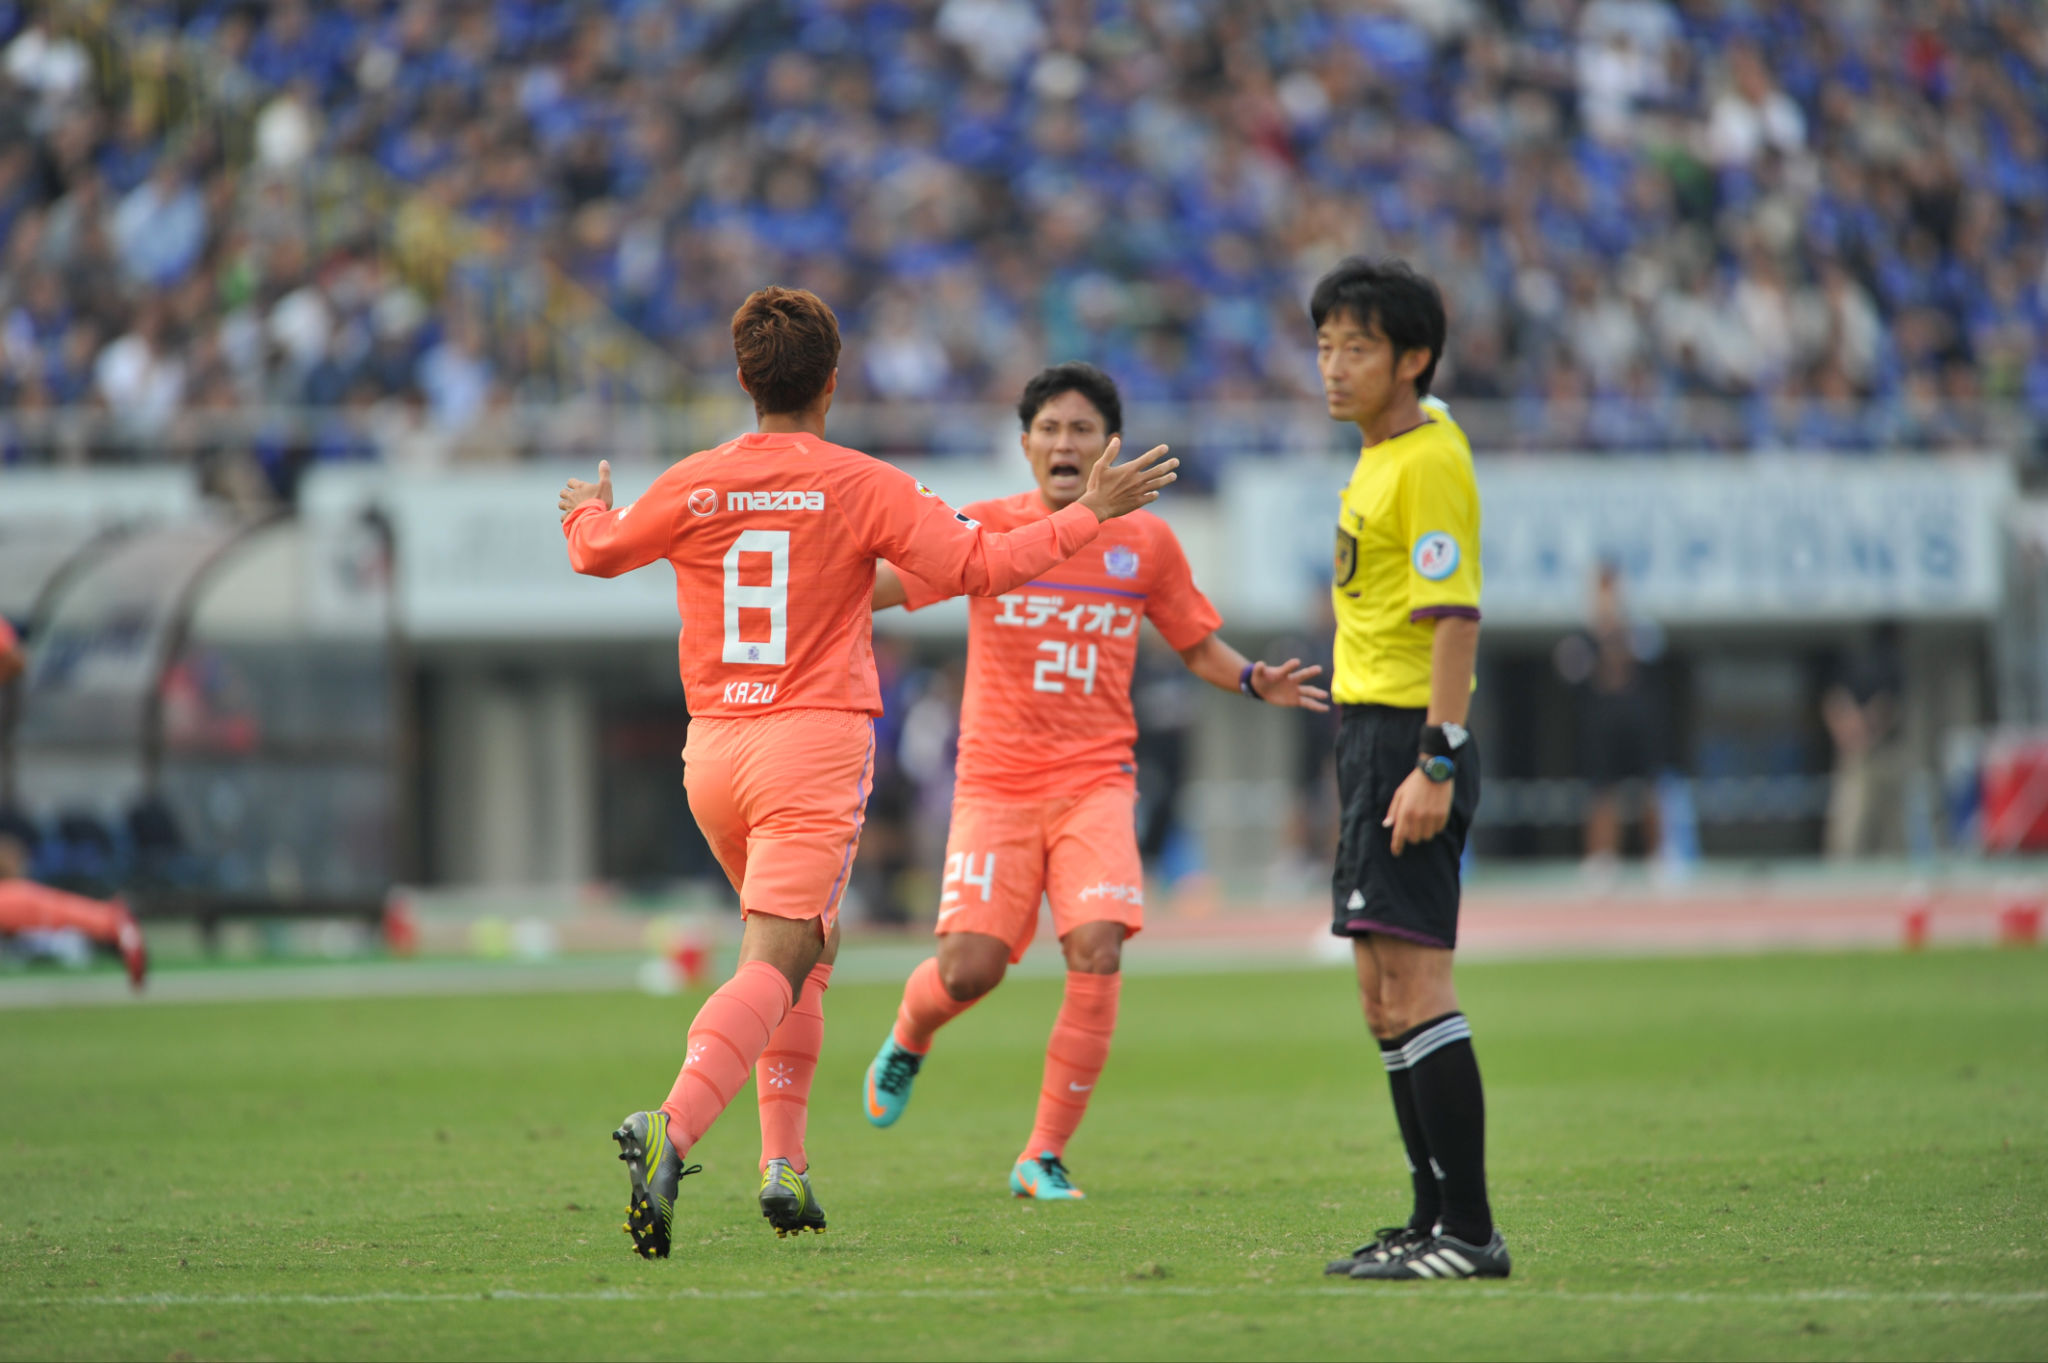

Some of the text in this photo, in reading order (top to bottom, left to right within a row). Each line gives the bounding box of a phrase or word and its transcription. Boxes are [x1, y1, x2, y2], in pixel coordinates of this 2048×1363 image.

[727, 491, 825, 511] mazda
[722, 529, 790, 665] 8
[994, 594, 1137, 637] エディオン
[1033, 640, 1097, 695] 24
[722, 682, 777, 704] KAZU
[941, 852, 996, 903] 24
